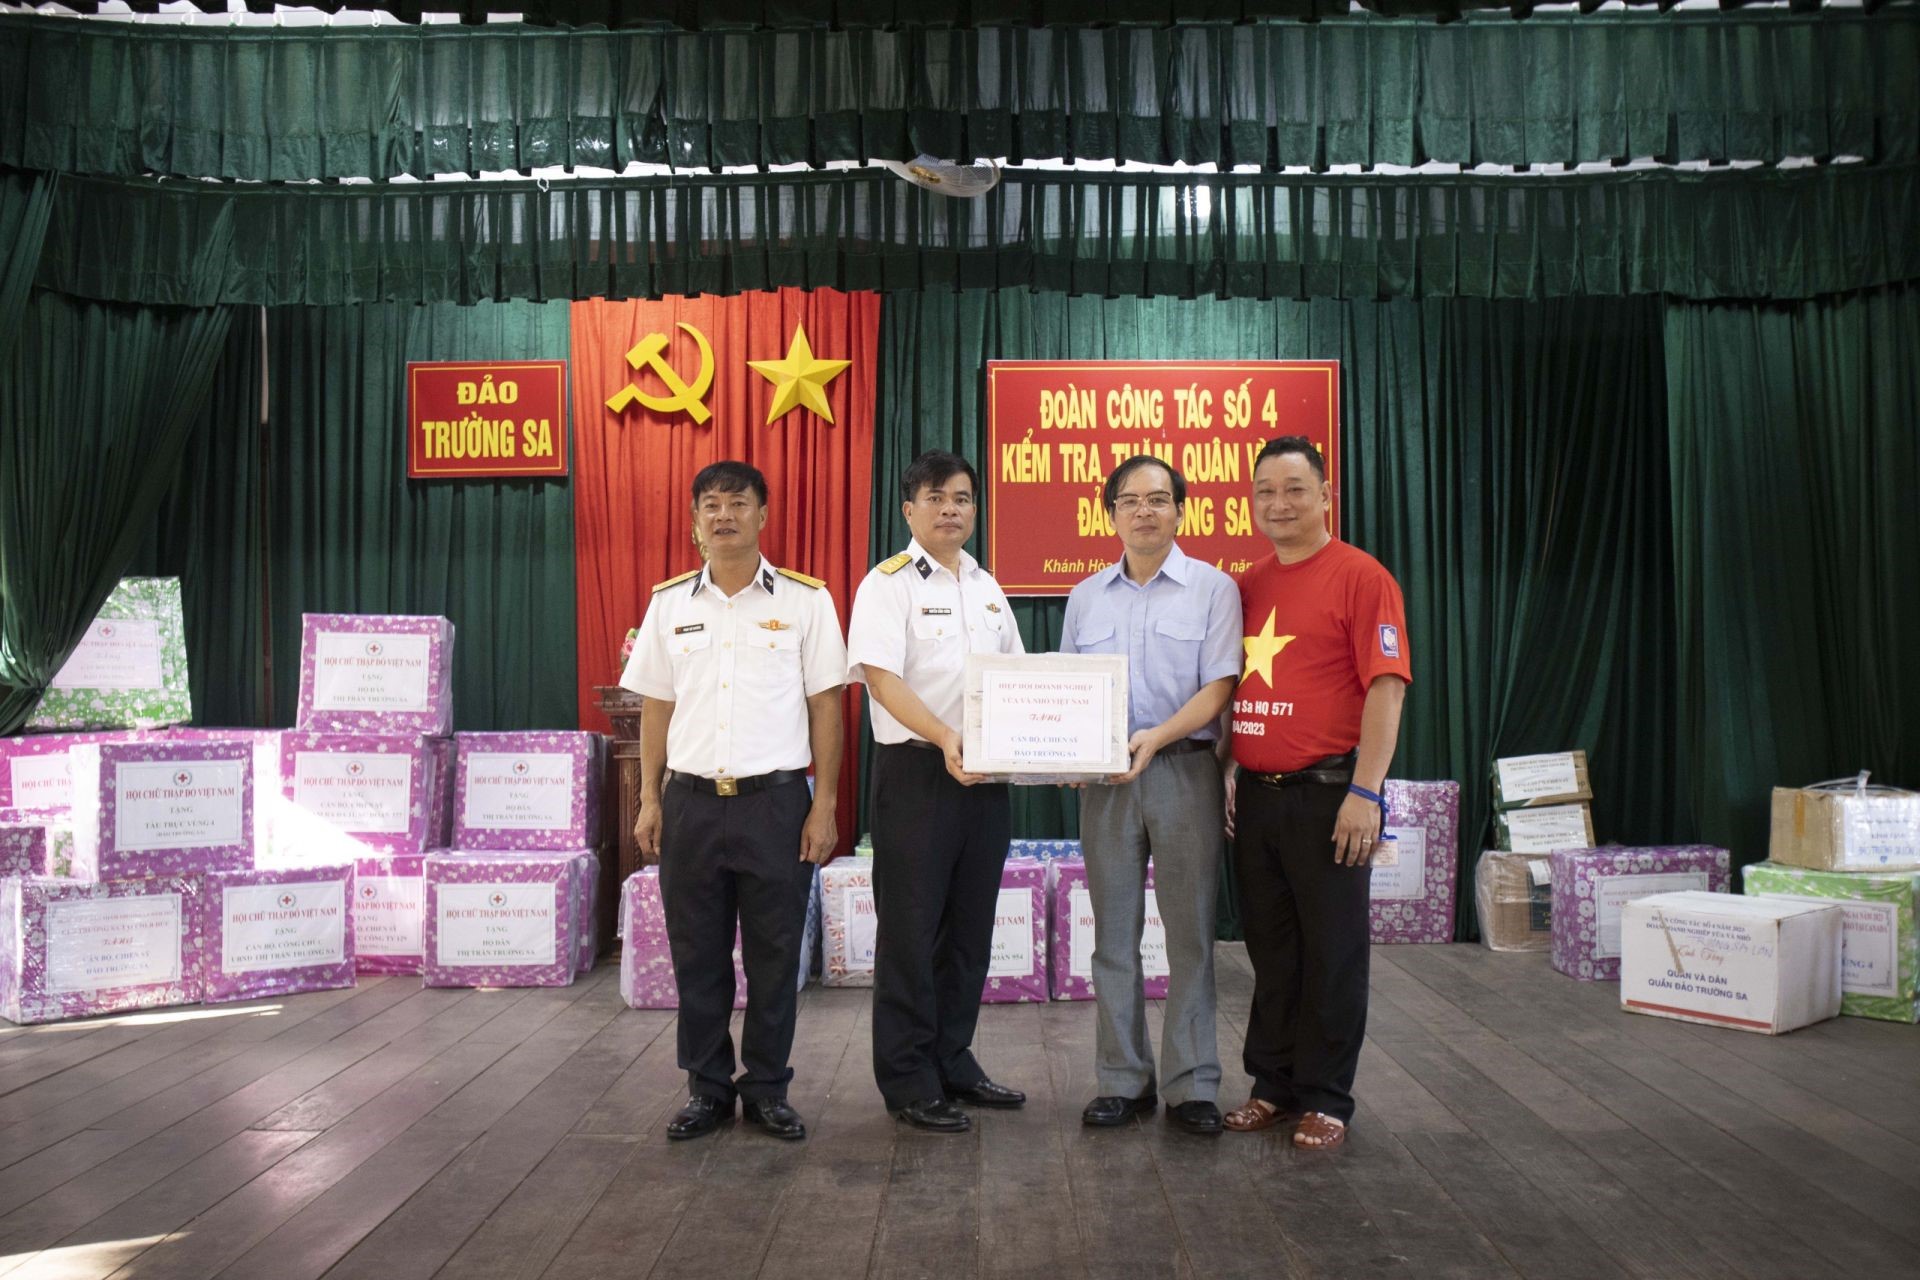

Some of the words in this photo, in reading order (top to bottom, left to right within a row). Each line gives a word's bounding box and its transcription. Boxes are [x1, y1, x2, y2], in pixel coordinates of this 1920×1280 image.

[457, 374, 518, 404] ĐẢO
[1040, 383, 1096, 429] ĐOÀN
[1106, 383, 1164, 429] CÔNG
[1173, 383, 1213, 429] TÁC
[1223, 378, 1253, 429] SỐ
[1261, 389, 1278, 429] 4
[422, 411, 515, 458] TRƯỜNG
[522, 419, 553, 457] SA
[1002, 428, 1050, 482] KIỂM
[1060, 443, 1107, 485] TRA,
[1182, 437, 1239, 484] QUÂN
[1224, 497, 1253, 537] SA
[1043, 559, 1085, 573] Khánh
[1242, 699, 1253, 713] Sa
[1255, 700, 1269, 716] HQ
[1272, 702, 1294, 716] 571
[217, 787, 235, 796] NAM
[320, 907, 337, 916] NAM
[1007, 915, 1025, 925] NAM
[1080, 916, 1094, 928] HỘI
[1148, 917, 1161, 928] VIỆ
